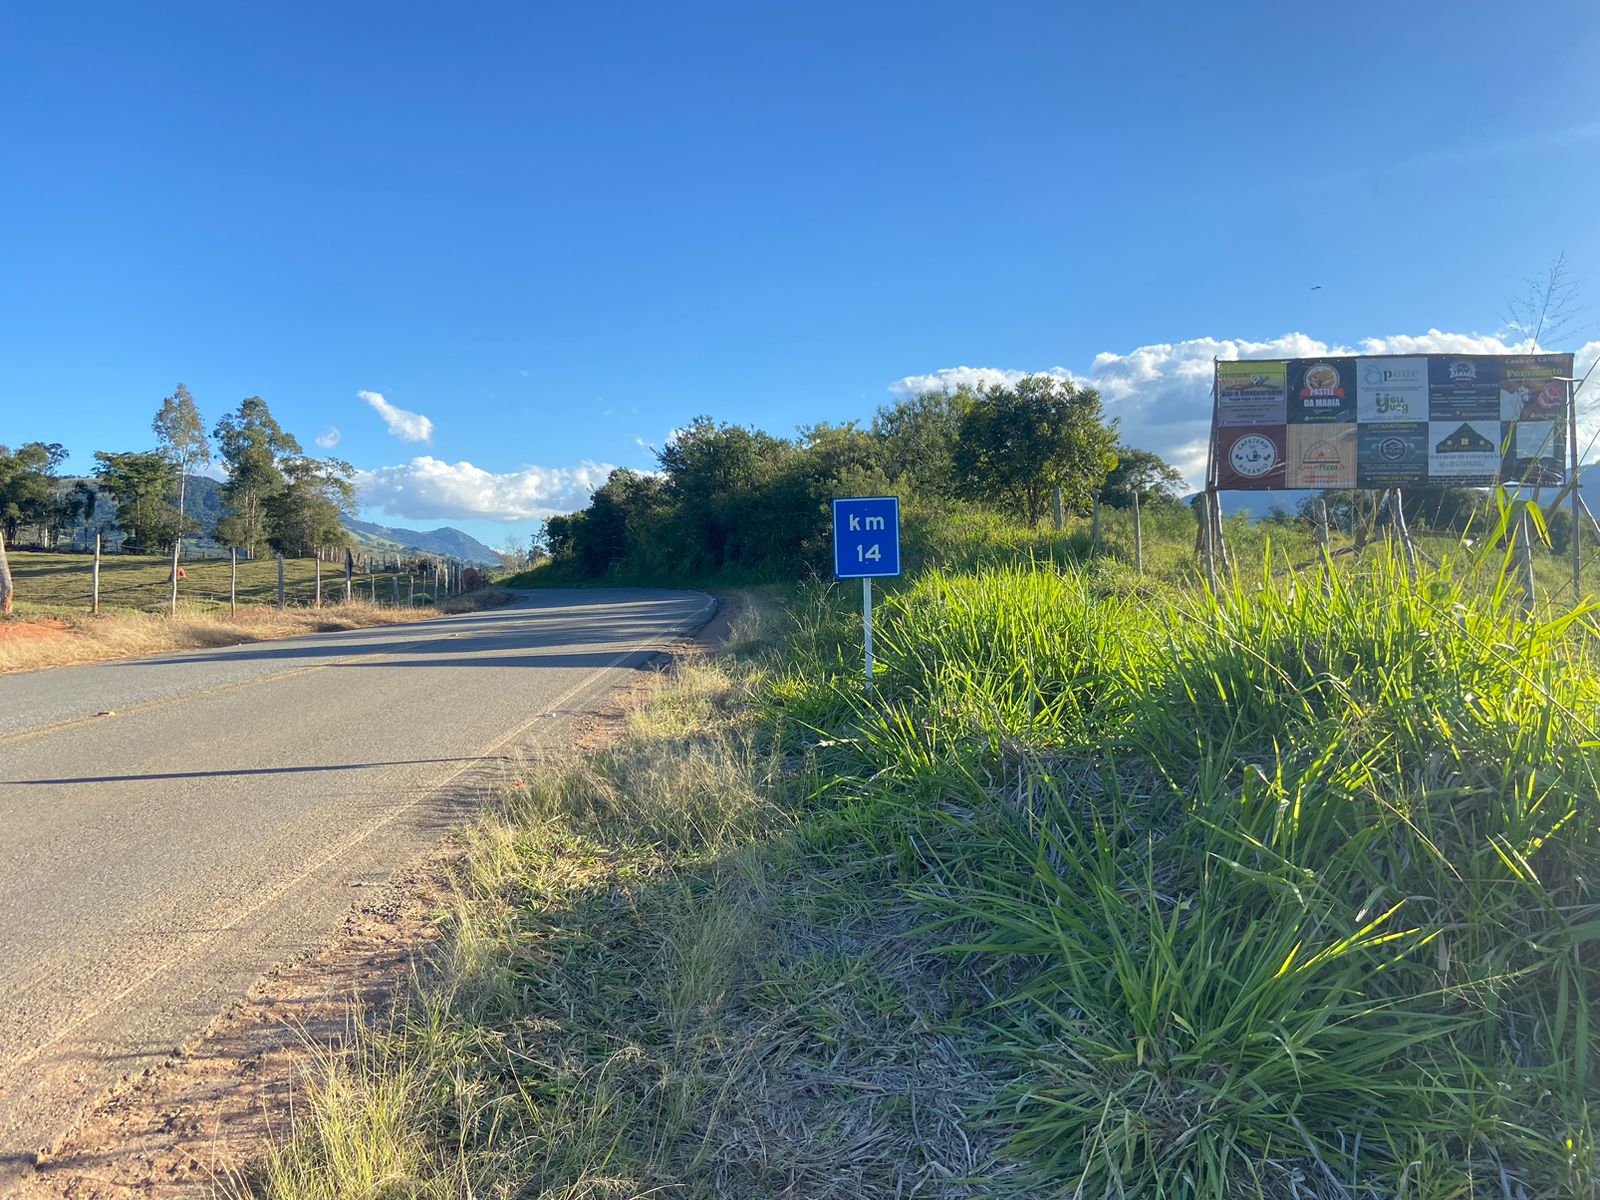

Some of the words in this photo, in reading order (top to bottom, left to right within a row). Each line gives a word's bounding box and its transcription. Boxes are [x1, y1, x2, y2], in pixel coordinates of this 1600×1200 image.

[1310, 387, 1334, 397] PASTEL
[1303, 398, 1314, 408] DA
[1315, 398, 1341, 408] MARIA
[1237, 438, 1269, 450] CAFETERIA
[849, 513, 885, 531] km
[856, 543, 881, 562] 14
